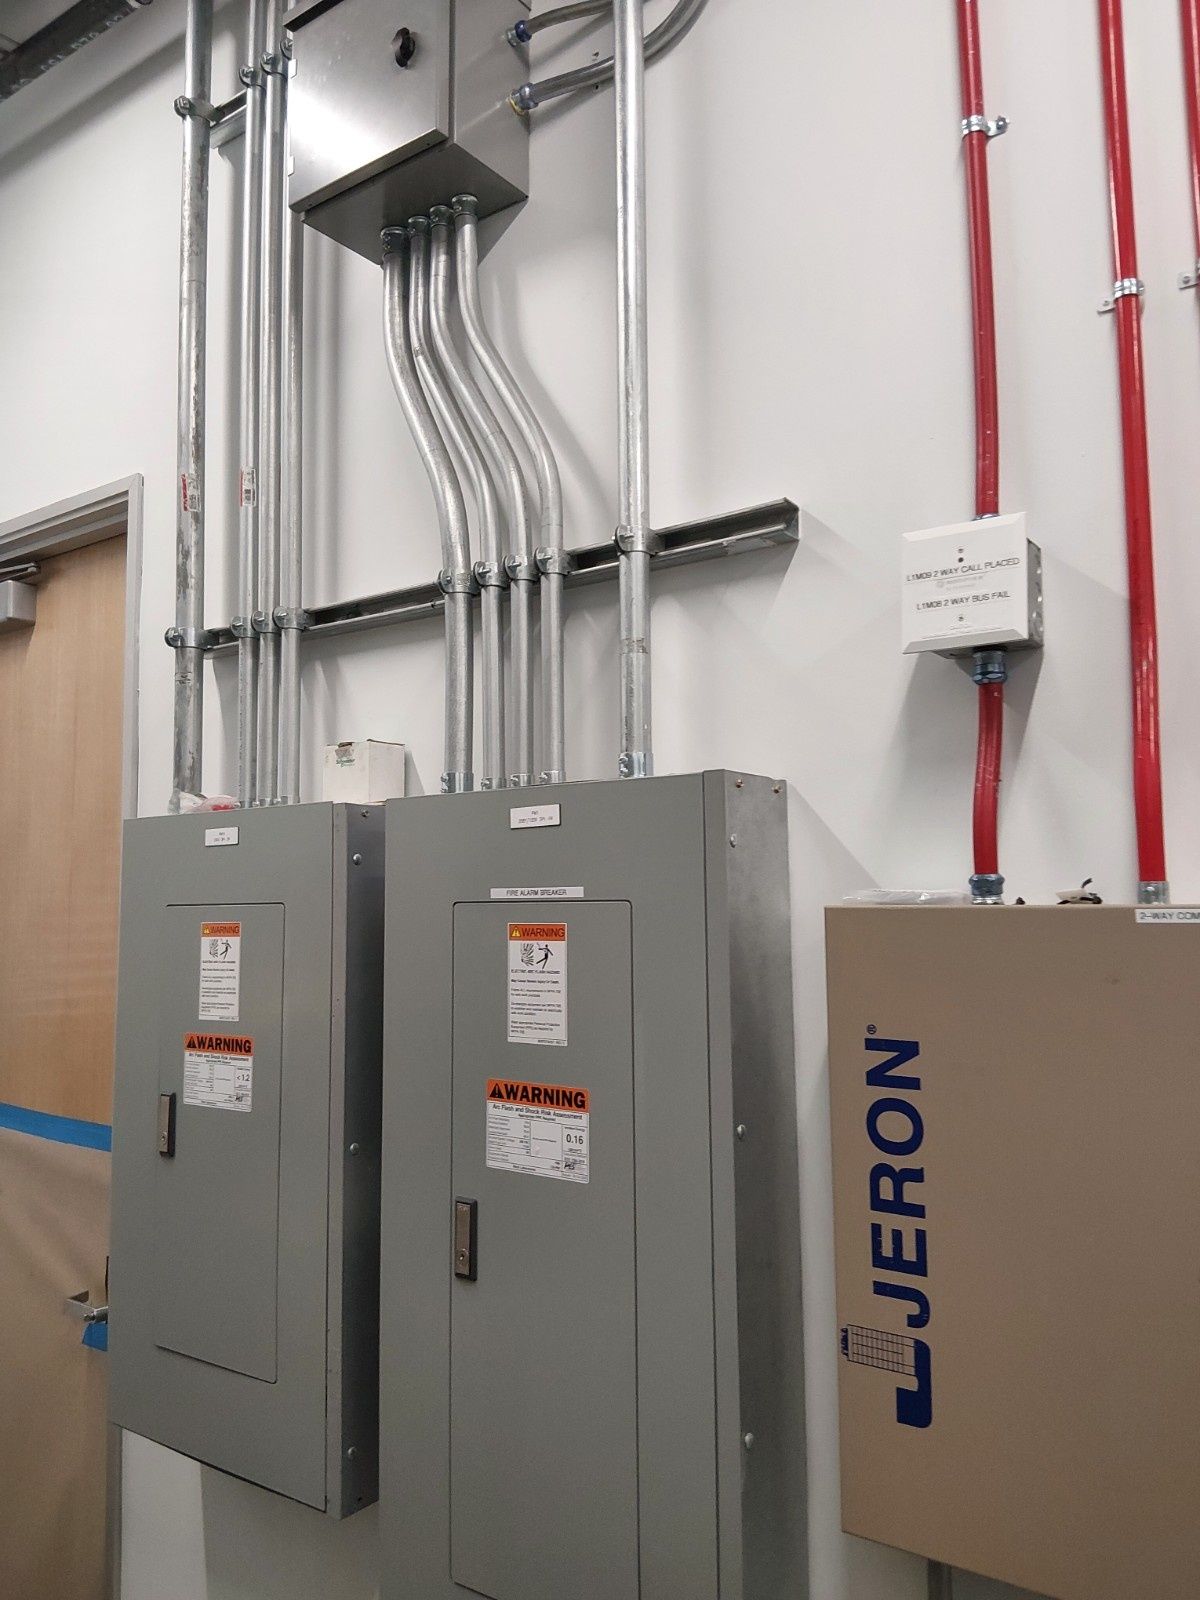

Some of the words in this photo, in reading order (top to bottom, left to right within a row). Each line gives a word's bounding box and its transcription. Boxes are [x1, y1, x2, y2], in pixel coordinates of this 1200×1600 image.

[933, 570, 940, 578] 2
[940, 567, 960, 576] WAY
[961, 564, 983, 573] CALL
[984, 557, 1020, 569] PLACED
[944, 599, 950, 607] 2
[951, 596, 971, 605] WAY
[972, 593, 990, 603] BUS
[991, 591, 1010, 600] FAIL
[506, 889, 518, 897] FIRE
[520, 889, 538, 897] ALARM
[540, 888, 567, 896] BREAKER
[1140, 911, 1174, 920] 2-WAY
[211, 925, 240, 935] WARNING
[521, 927, 565, 938] WARNING
[196, 1035, 252, 1053] WARNING
[504, 1083, 585, 1109] WARNING
[552, 1111, 582, 1119] Assessment
[566, 1133, 583, 1144] 0.16
[864, 1037, 931, 1329] JERON
